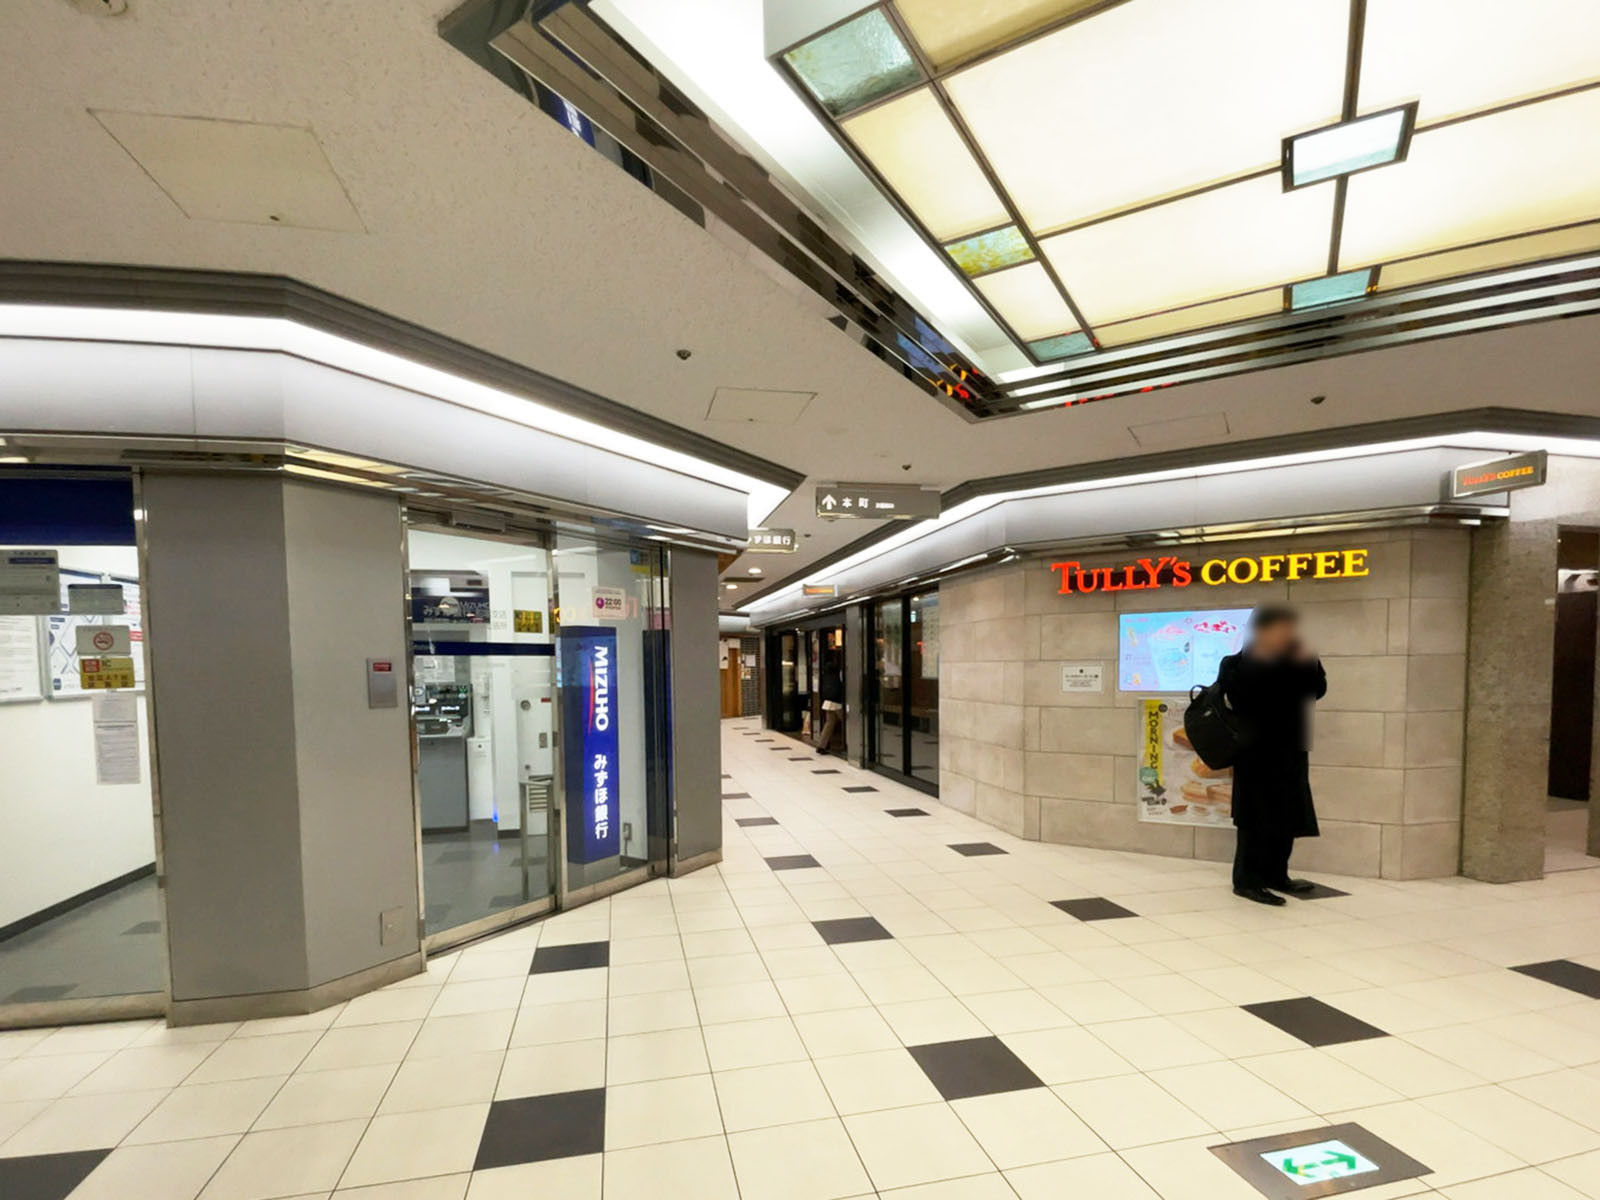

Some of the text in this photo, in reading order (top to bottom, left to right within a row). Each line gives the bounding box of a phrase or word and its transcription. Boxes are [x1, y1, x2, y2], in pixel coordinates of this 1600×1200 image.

[1496, 466, 1534, 479] COFFEE
[842, 496, 869, 509] 本町
[1051, 549, 1369, 594] TULLY'S COFFEE
[594, 645, 609, 731] MIZUHO
[594, 753, 608, 840] みずほ銀行
